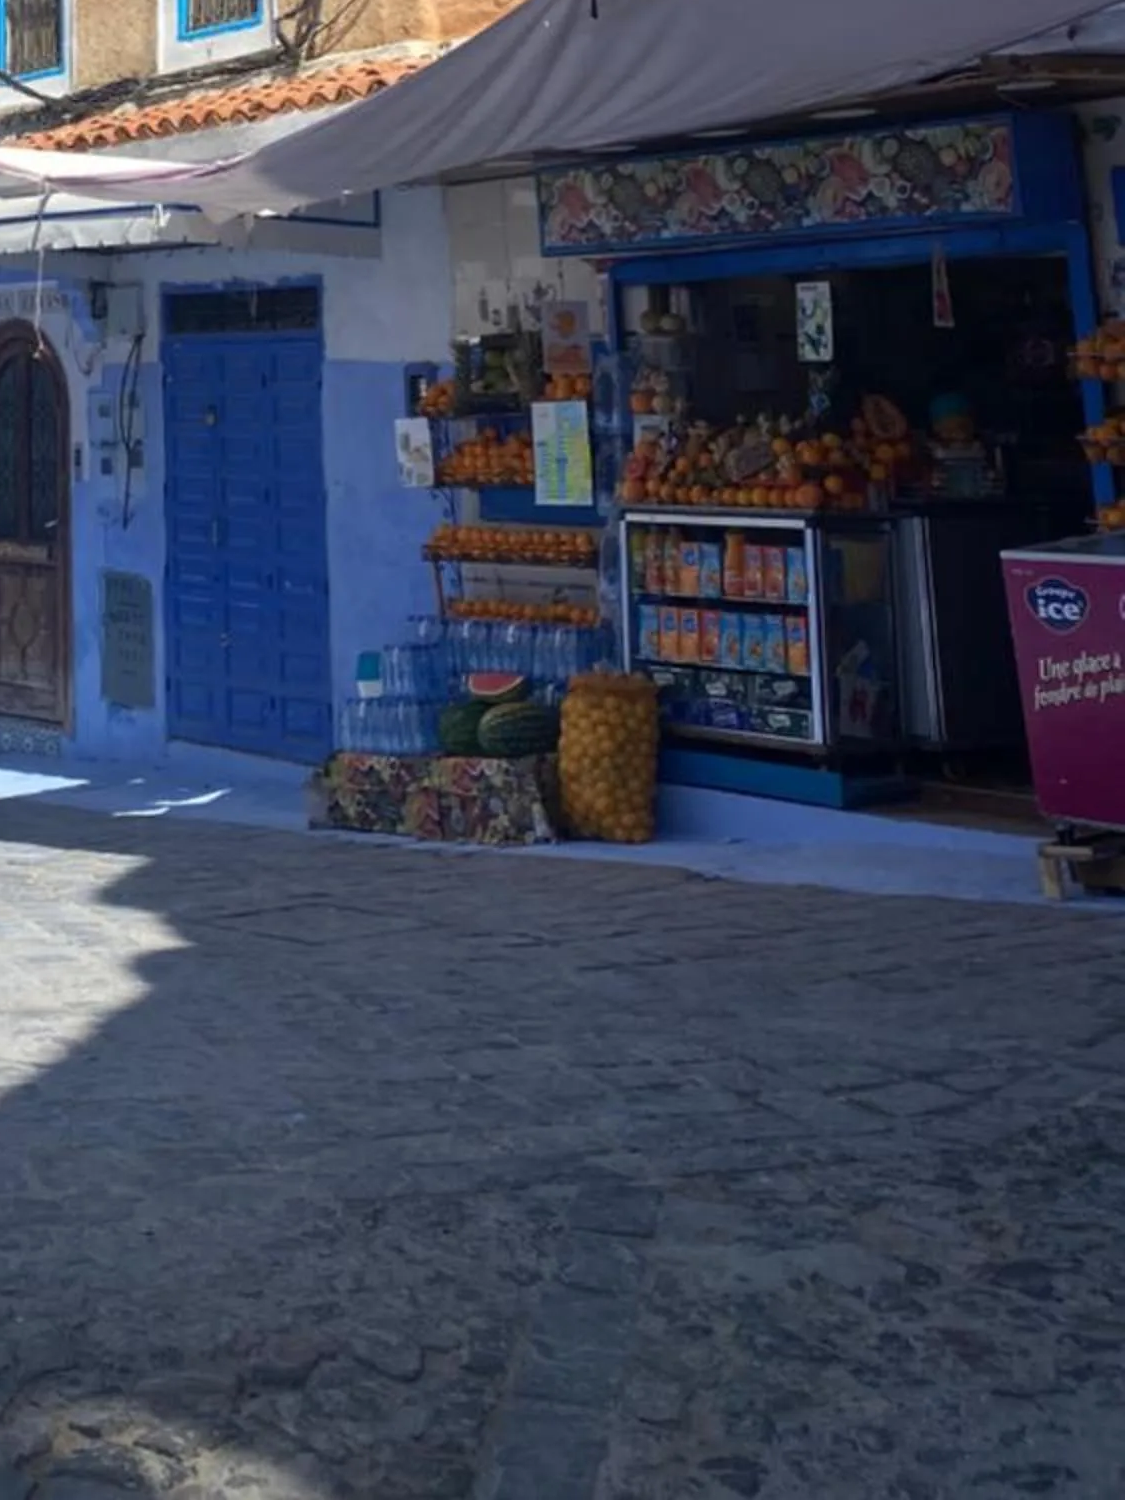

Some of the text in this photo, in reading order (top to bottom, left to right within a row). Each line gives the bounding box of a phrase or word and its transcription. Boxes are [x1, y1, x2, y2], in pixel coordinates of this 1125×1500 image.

[1037, 598, 1080, 620] ice
[1038, 657, 1070, 681] Une
[1073, 651, 1111, 683] glace
